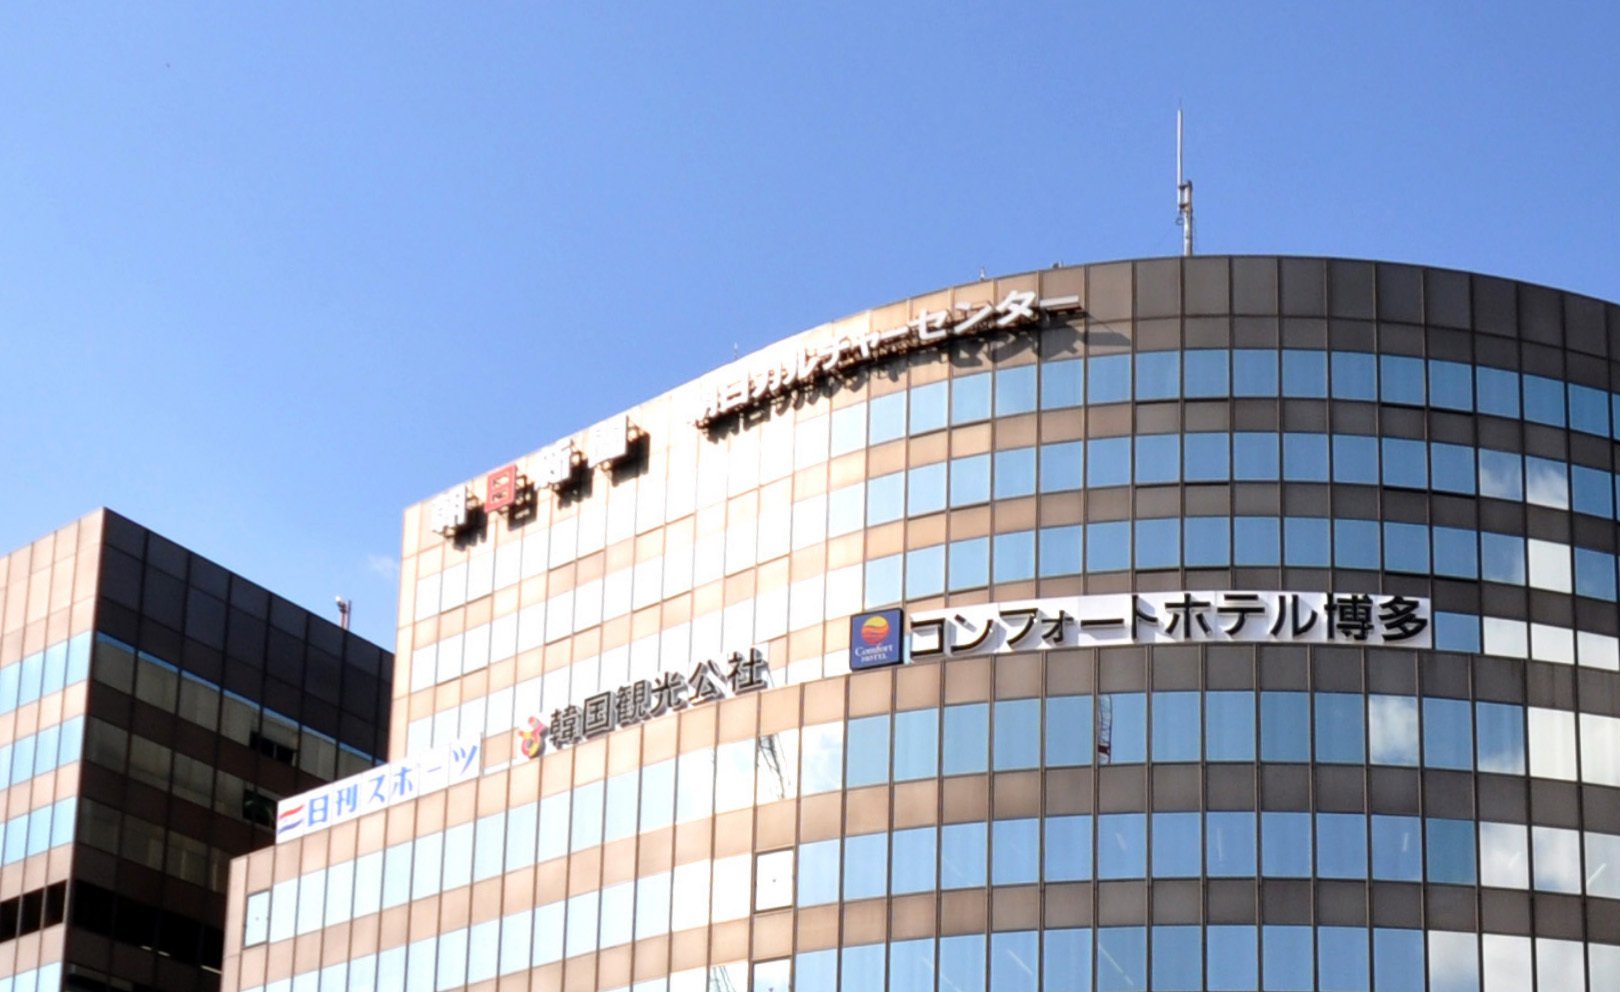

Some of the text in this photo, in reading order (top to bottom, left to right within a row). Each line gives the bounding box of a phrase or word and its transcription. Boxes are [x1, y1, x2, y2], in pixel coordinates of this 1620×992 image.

[855, 642, 894, 657] Comfort
[910, 592, 1429, 661] コンフォートホテル博多
[549, 646, 769, 749] 韓国観光公社
[306, 744, 480, 828] 日刊スポーツ
